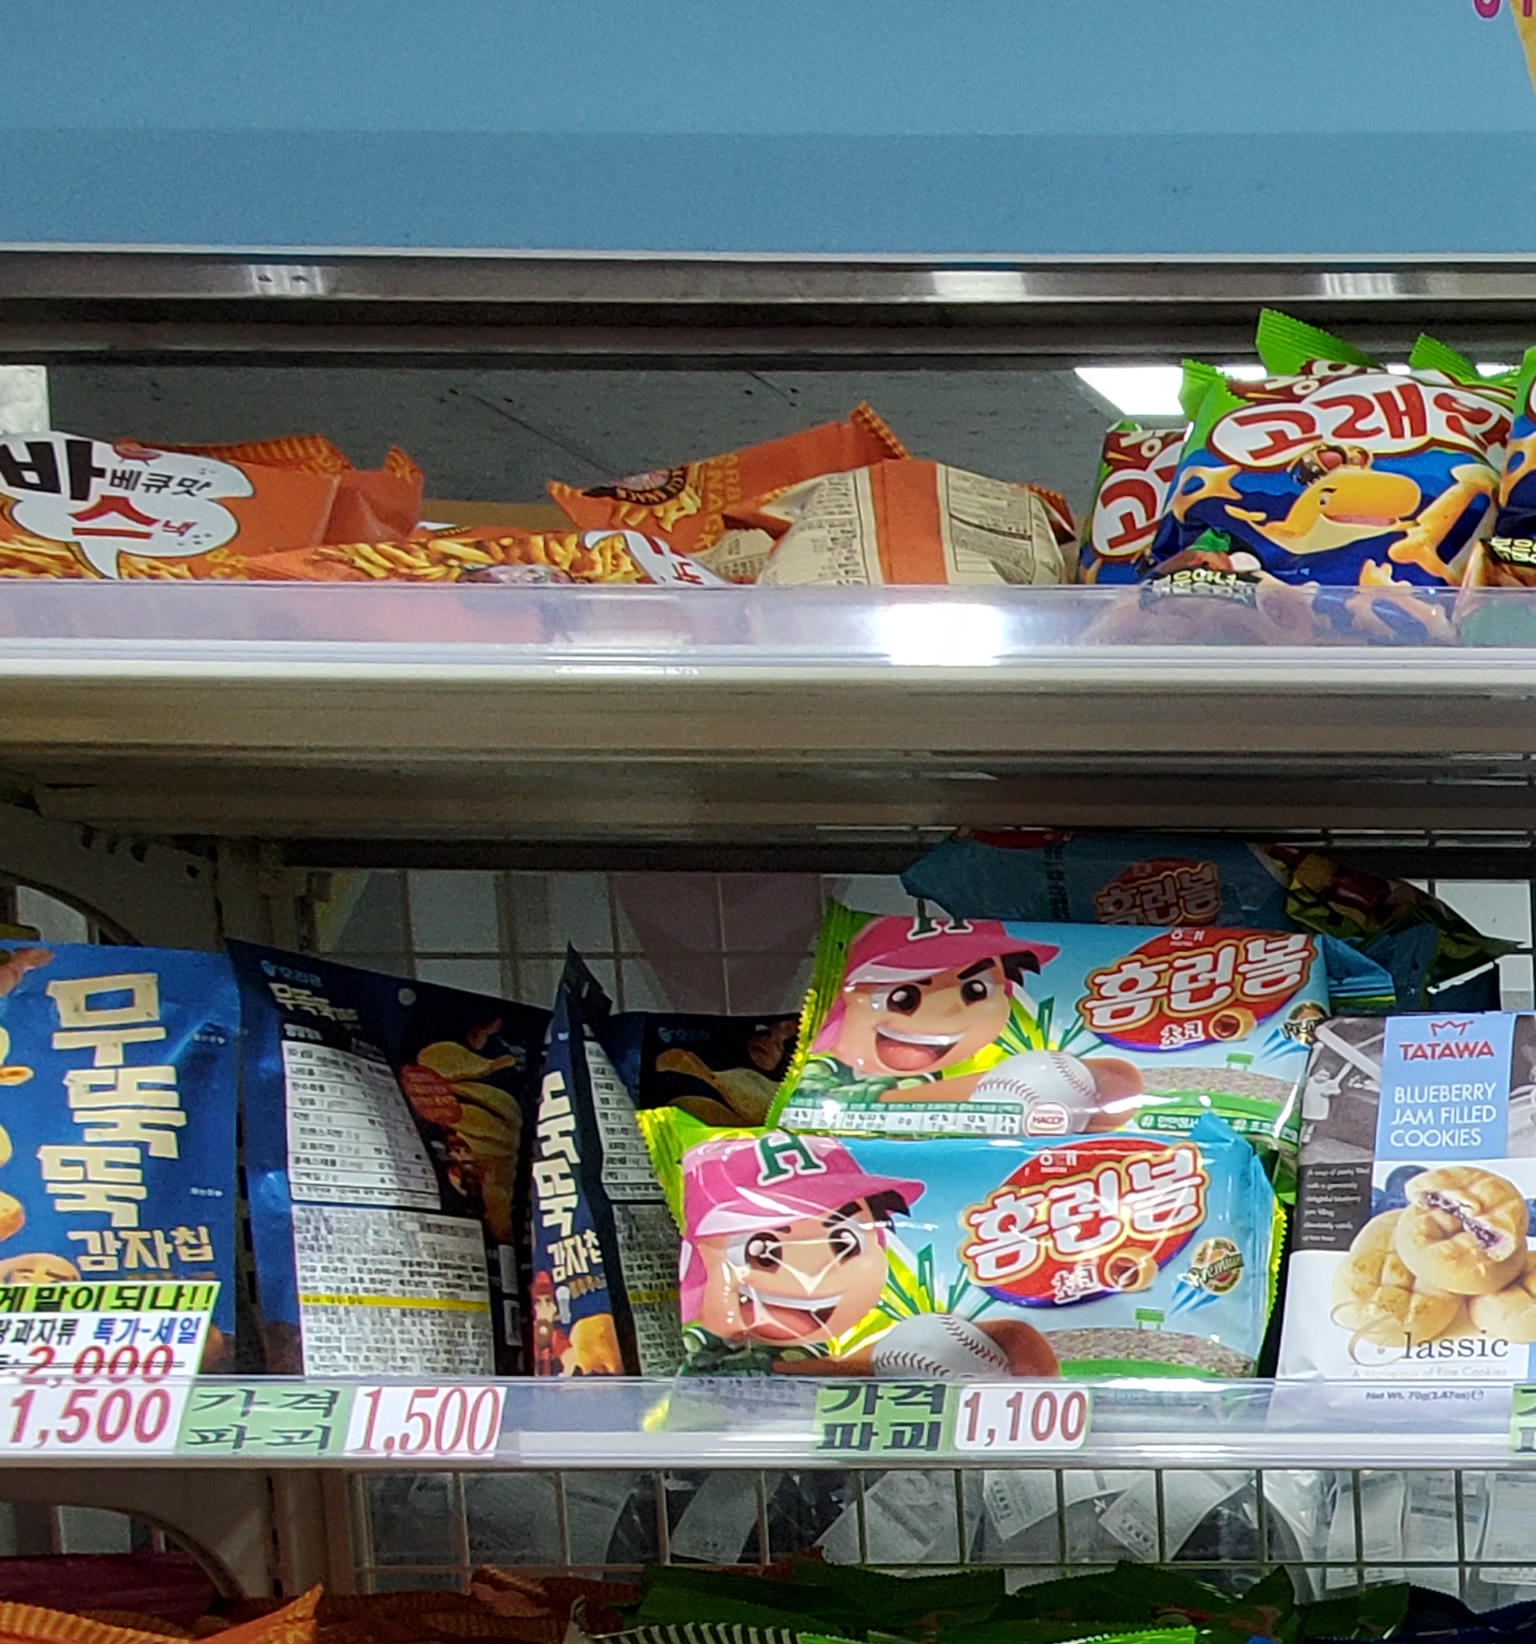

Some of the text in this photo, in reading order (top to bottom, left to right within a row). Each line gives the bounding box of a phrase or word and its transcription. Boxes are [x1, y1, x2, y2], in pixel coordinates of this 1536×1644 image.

[1084, 934, 1315, 1028] 홈런볼
[1160, 1021, 1205, 1046] 초코
[1399, 1039, 1495, 1062] TATAWA
[37, 971, 189, 1229] 무뚝뚝
[1394, 1082, 1496, 1107] BLUEBERRY
[1032, 1114, 1066, 1125] HACCP
[1390, 1105, 1496, 1127] JAM FILLED
[1390, 1128, 1482, 1148] COOKIES
[756, 1133, 826, 1184] H
[964, 1147, 1209, 1286] 홈런볼
[67, 1225, 213, 1272] 감자칩
[1052, 1267, 1097, 1304] 초코
[1330, 1300, 1509, 1367] Classic
[20, 1345, 174, 1389] 2,000
[191, 1388, 338, 1419] 가격
[821, 1384, 946, 1414] 가격
[10, 1389, 171, 1448] 1,500
[353, 1387, 500, 1457] 1,500
[817, 1422, 942, 1451] 파괴
[963, 1388, 1087, 1448] 1,100
[185, 1426, 331, 1453] 파괴
